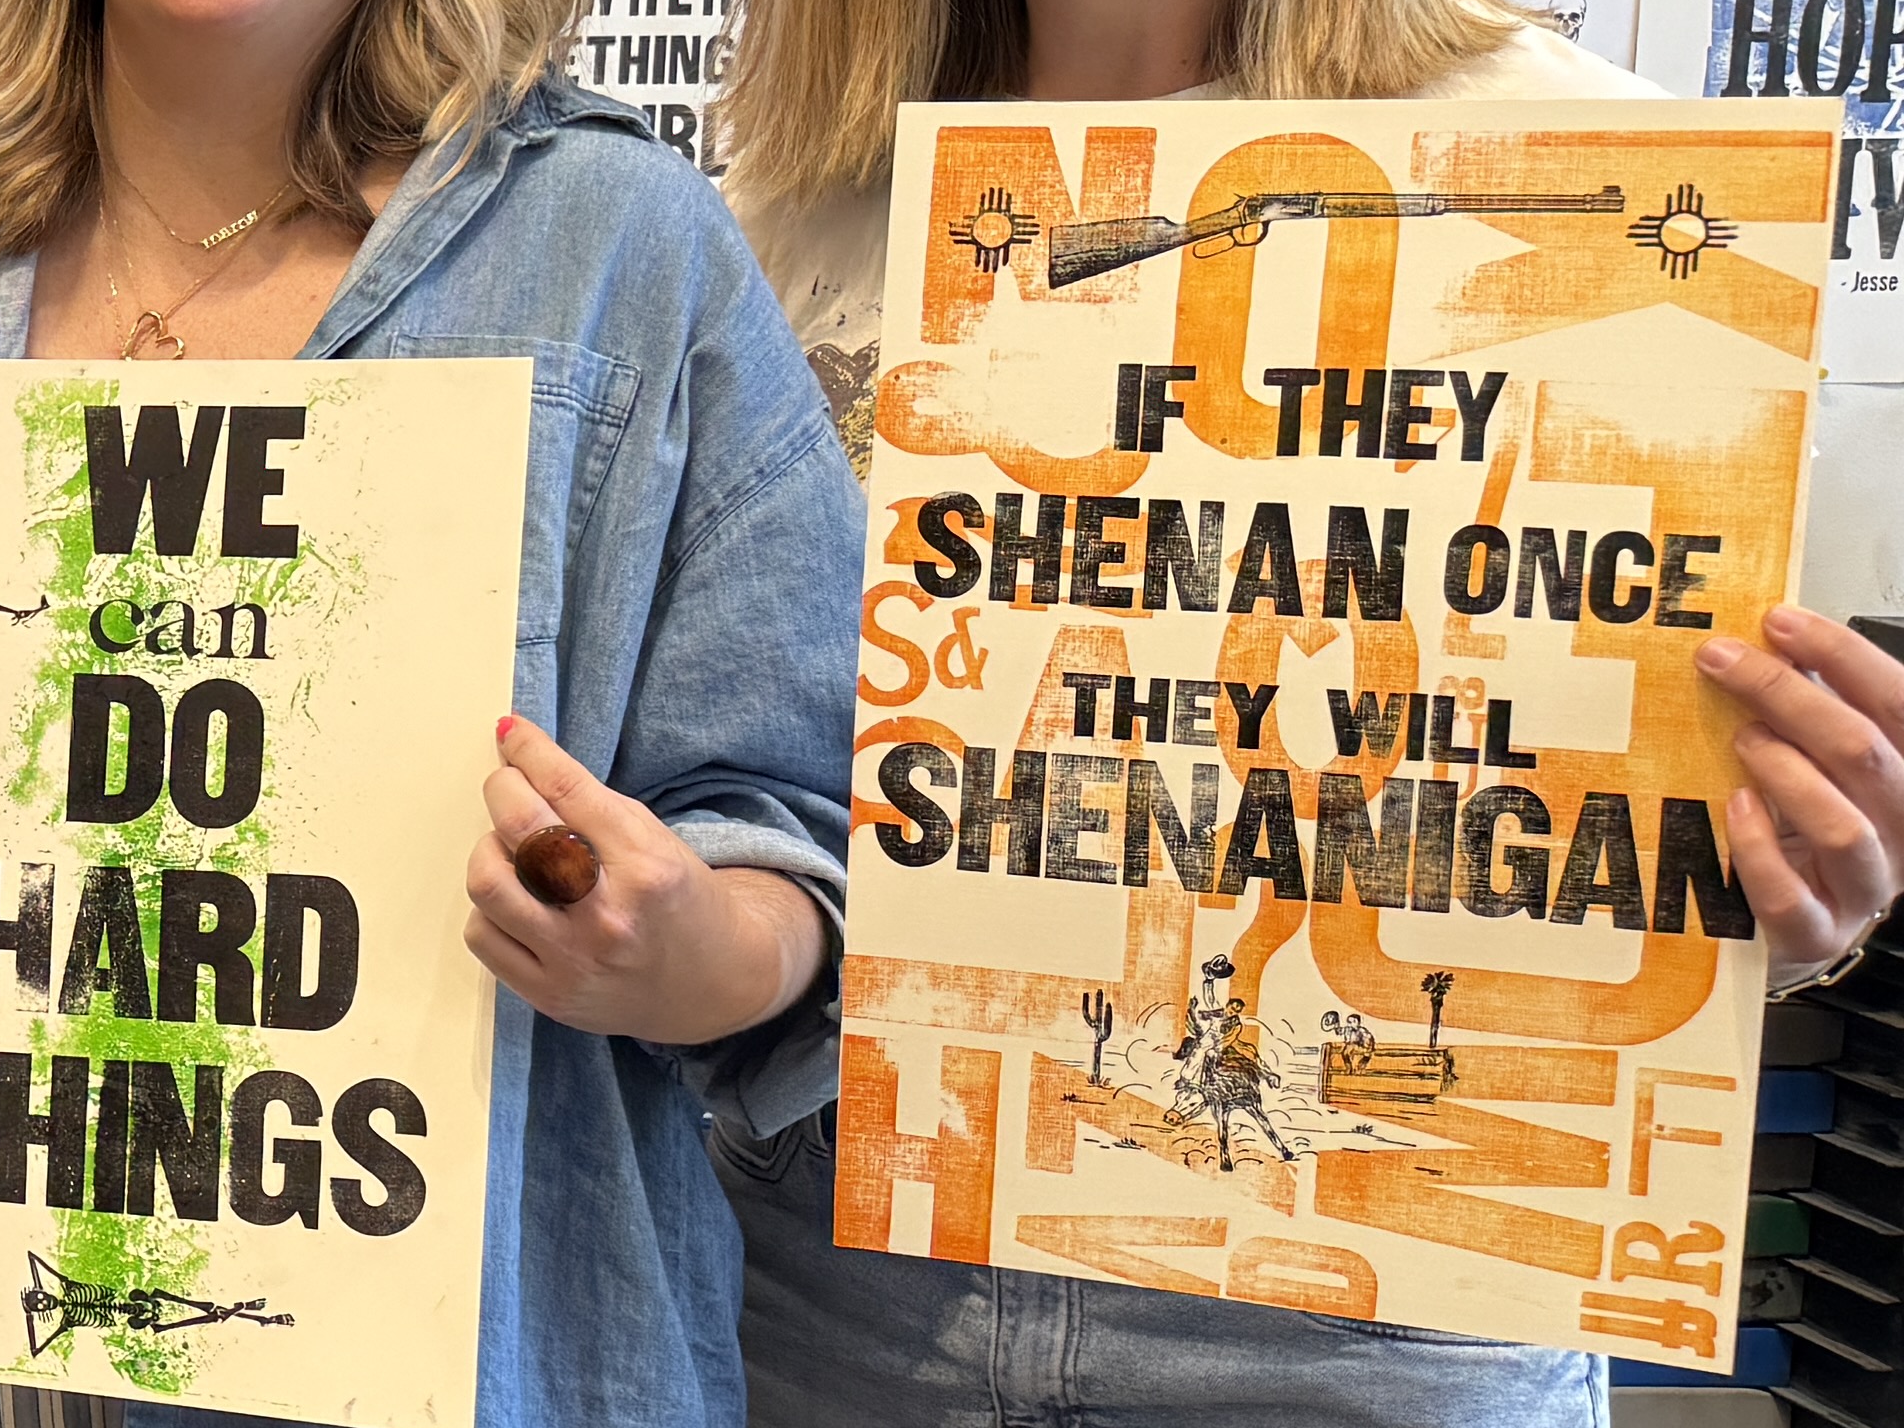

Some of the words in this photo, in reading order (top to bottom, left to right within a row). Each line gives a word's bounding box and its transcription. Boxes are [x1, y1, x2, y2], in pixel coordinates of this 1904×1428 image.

[1851, 270, 1898, 293] Jesse
[1113, 363, 1195, 455] IF
[1263, 368, 1508, 464] THEY
[84, 405, 306, 559] WE
[913, 491, 1409, 623] SHENAN
[1443, 522, 1722, 631] ONCE
[88, 599, 276, 661] can
[65, 674, 265, 829] DO
[1062, 672, 1278, 752] THEY
[1327, 687, 1542, 770] WILL
[874, 742, 1755, 943] SHENANIGAN
